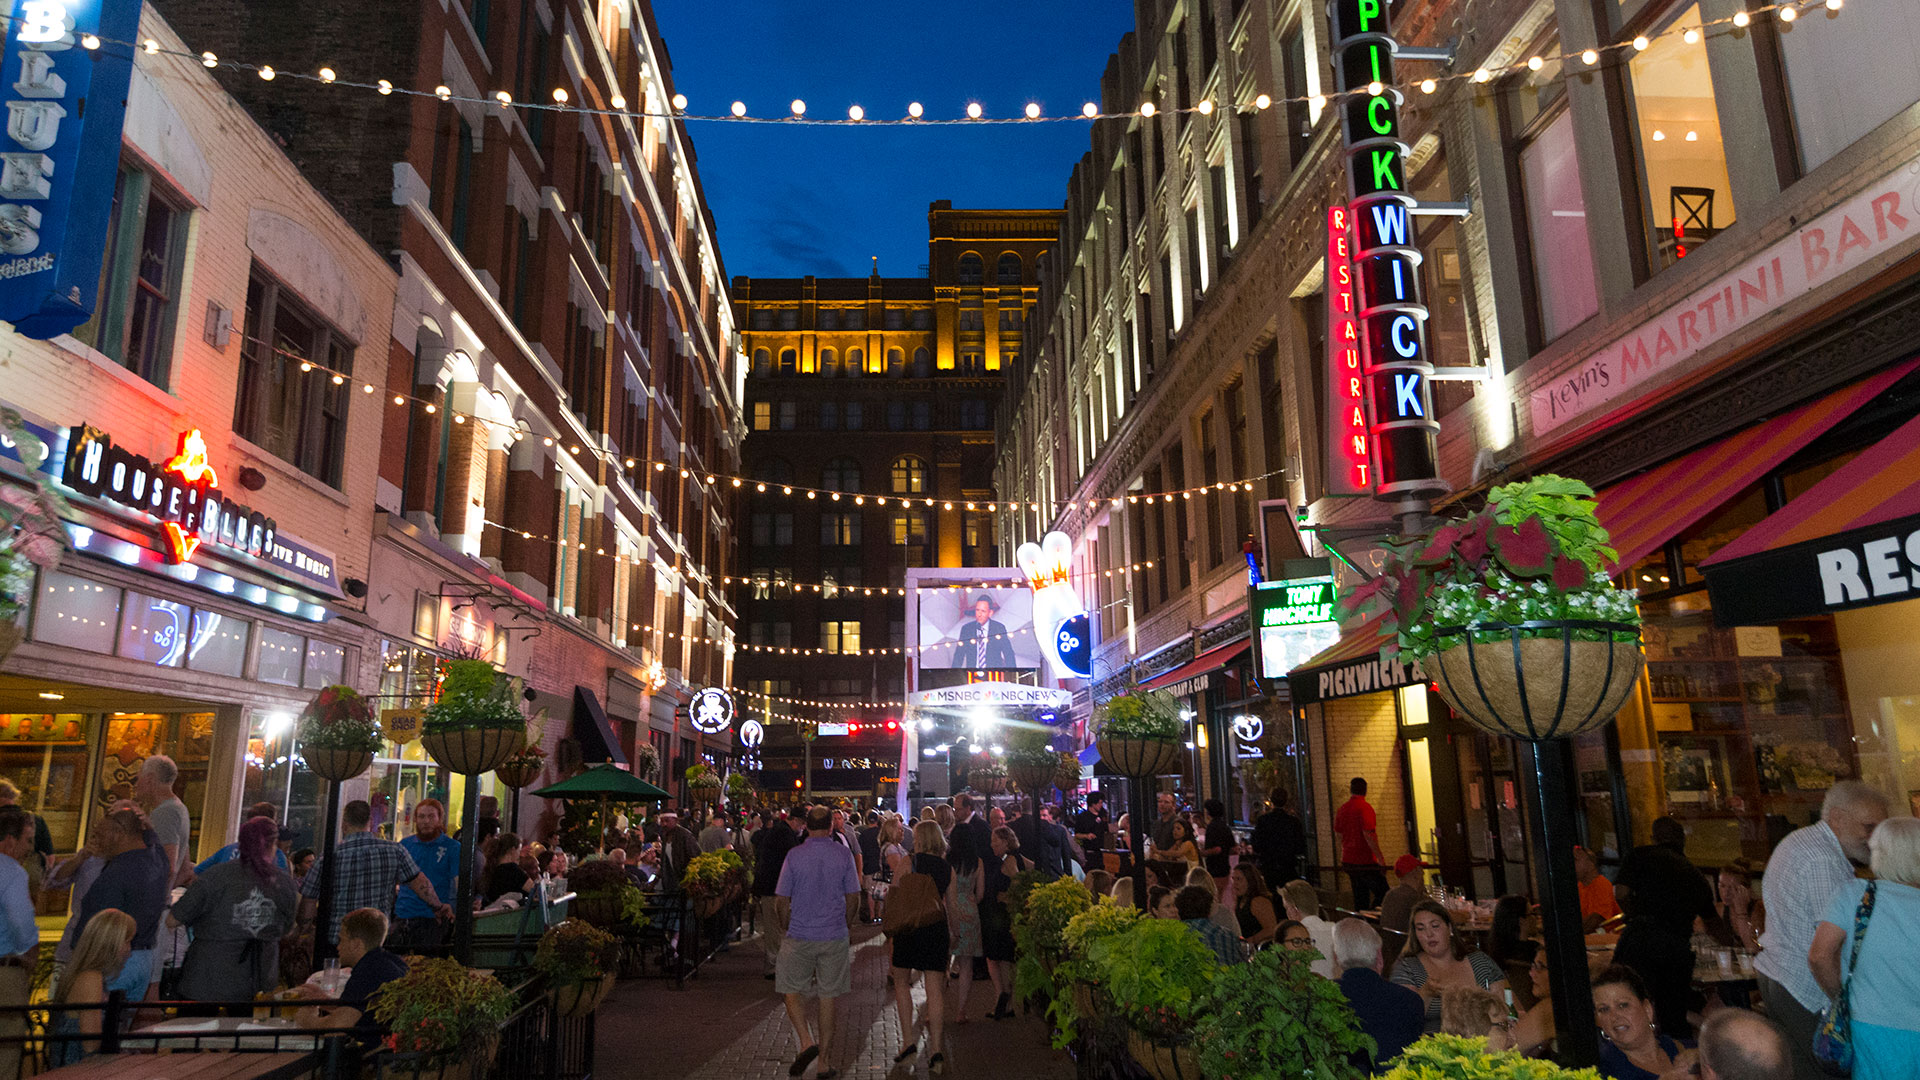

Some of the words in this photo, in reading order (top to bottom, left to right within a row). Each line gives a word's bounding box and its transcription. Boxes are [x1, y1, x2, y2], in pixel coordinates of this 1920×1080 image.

[0, 2, 76, 255] BLUES
[1619, 257, 1785, 384] MARTINI
[1801, 191, 1910, 281] BAR
[1333, 209, 1368, 488] RESTAURANT
[82, 439, 182, 515] HOUSE
[186, 489, 197, 528] OF
[202, 498, 274, 553] BLUES
[273, 543, 294, 564] IVE
[295, 551, 331, 580] MUSIC
[1286, 584, 1325, 605] TONY
[937, 690, 981, 702] MSNBC
[1001, 690, 1025, 702] NBC
[1026, 690, 1058, 702] NEWS
[1319, 657, 1407, 699] PICKWICK
